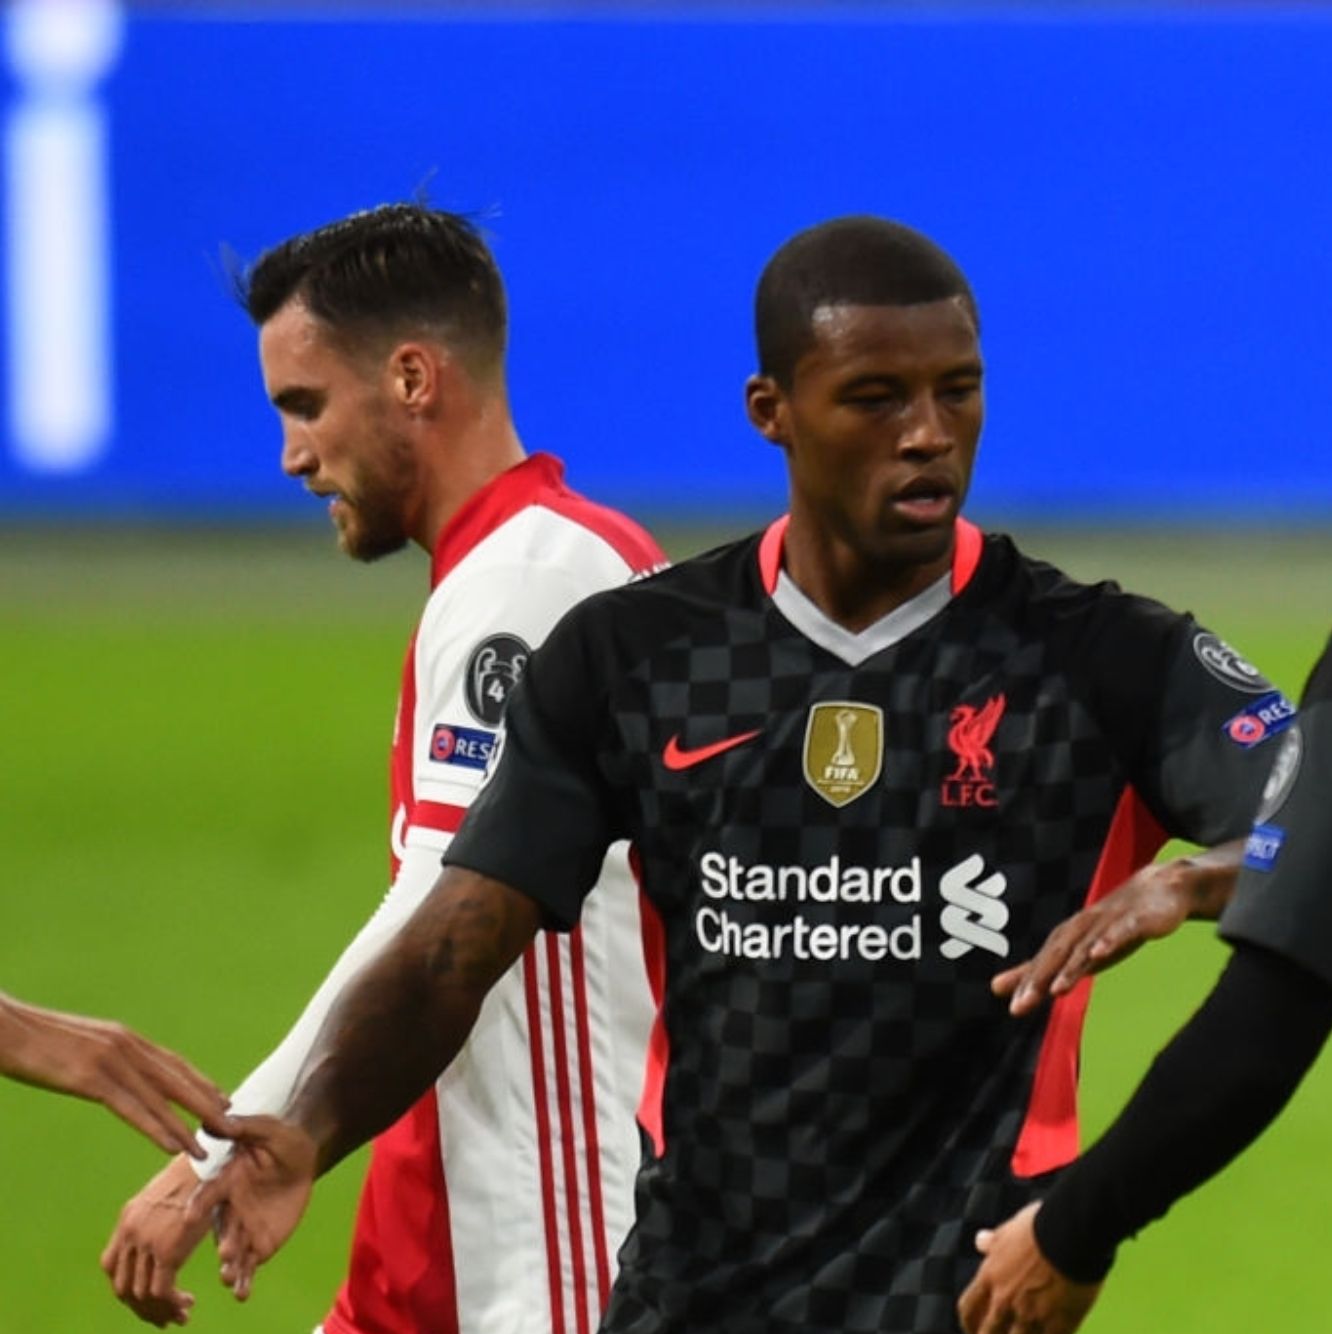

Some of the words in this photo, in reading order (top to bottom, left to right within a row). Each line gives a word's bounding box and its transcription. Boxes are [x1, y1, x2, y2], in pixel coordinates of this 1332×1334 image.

[487, 679, 505, 703] 4
[1257, 699, 1296, 727] RES
[455, 738, 491, 761] RES
[824, 766, 860, 781] FIFA
[701, 852, 921, 902] Standard
[696, 907, 921, 960] Chartered
